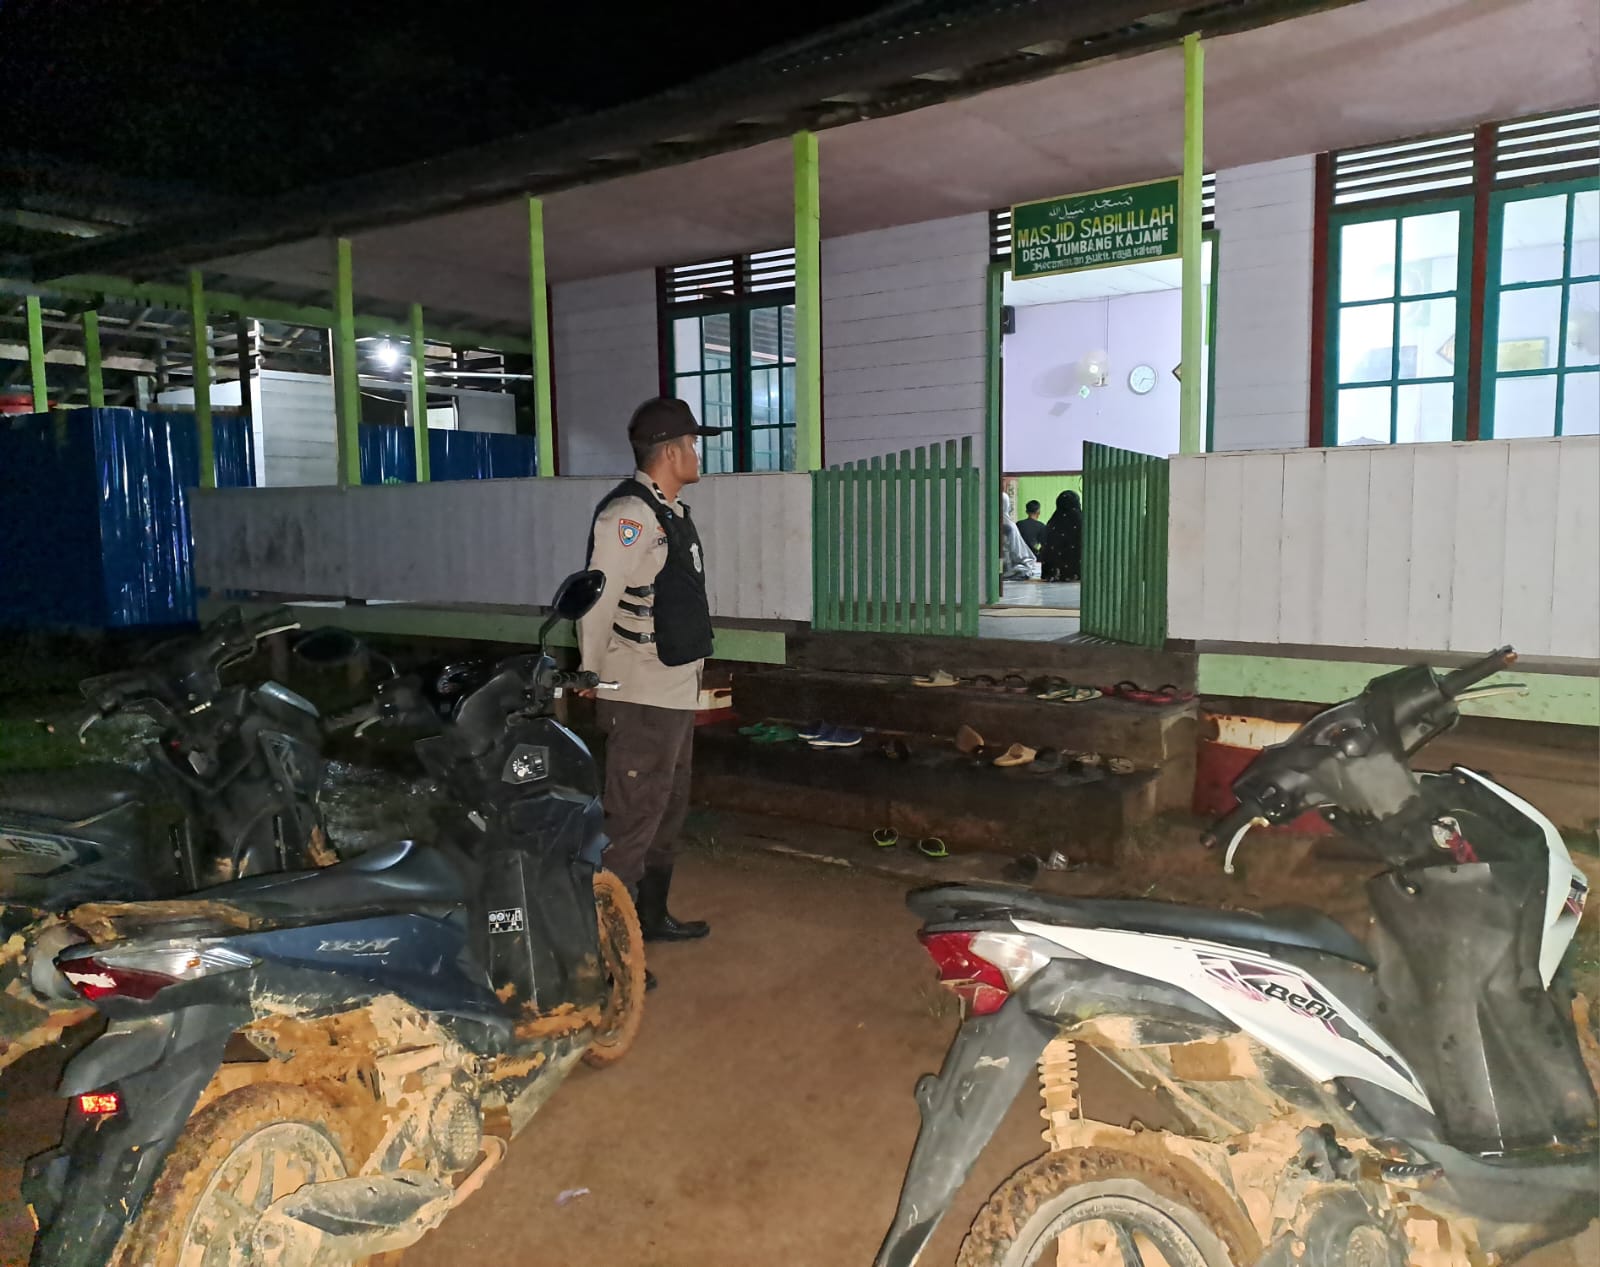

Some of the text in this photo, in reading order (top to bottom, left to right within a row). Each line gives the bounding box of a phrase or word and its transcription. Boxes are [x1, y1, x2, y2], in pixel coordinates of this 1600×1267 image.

[1017, 204, 1174, 248] MASJID SABILILLAH
[1022, 227, 1169, 262] DESA TUMBANG KAJAME
